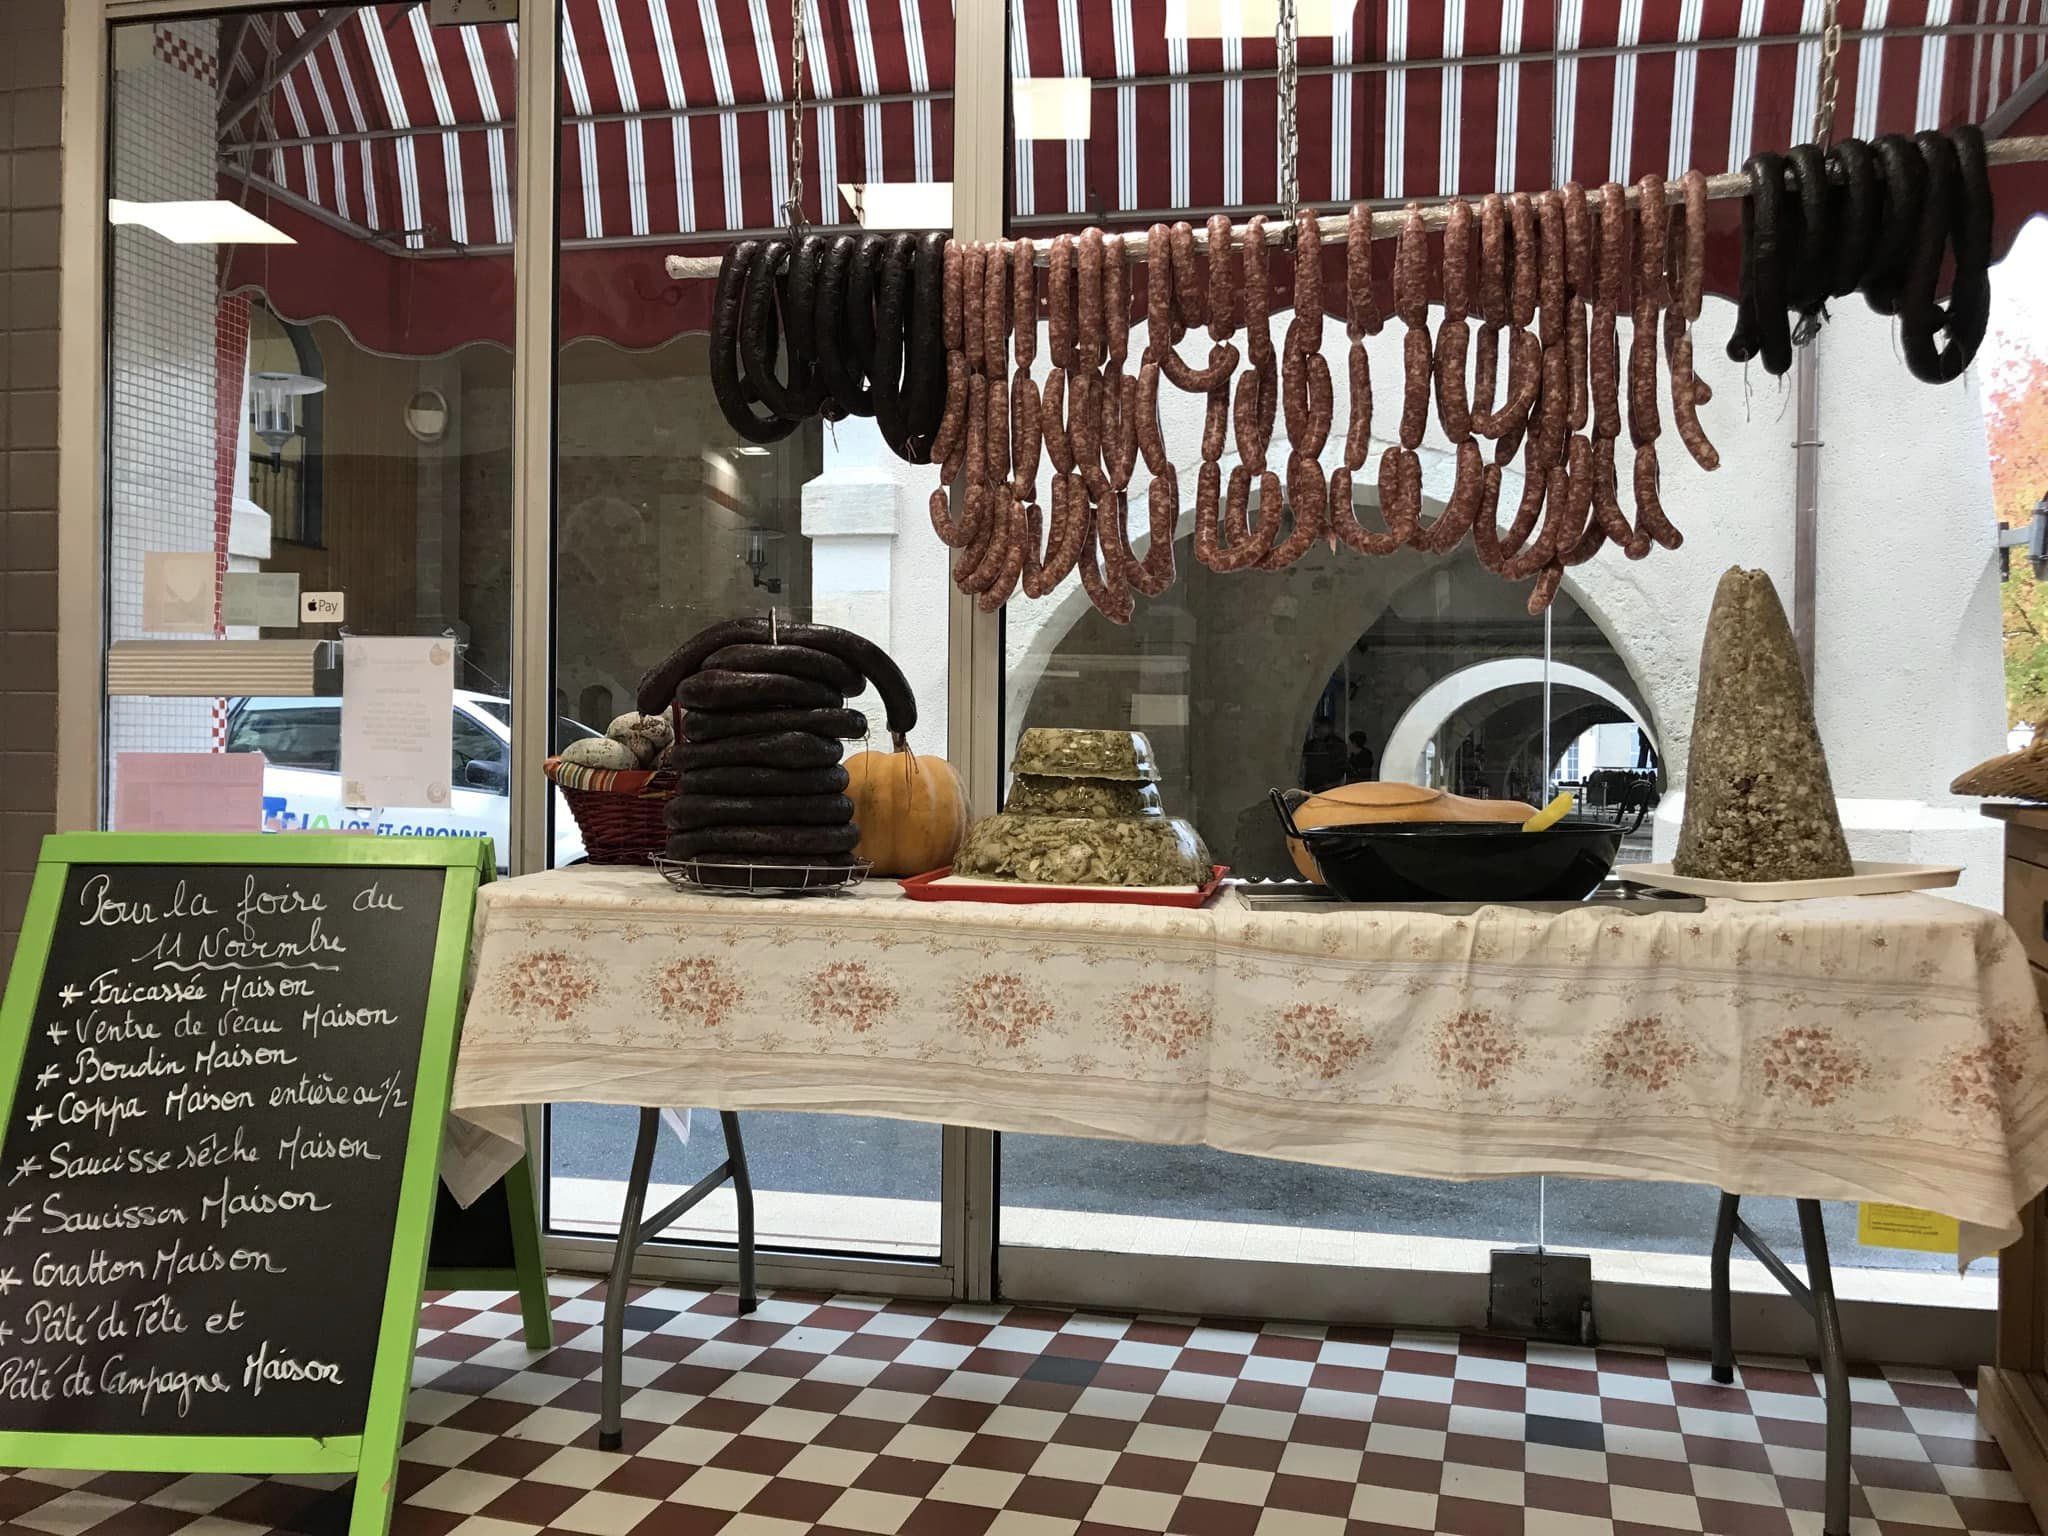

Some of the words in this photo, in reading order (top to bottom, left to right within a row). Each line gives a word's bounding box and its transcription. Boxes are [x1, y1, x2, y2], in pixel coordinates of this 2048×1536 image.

[319, 599, 338, 615] Pay
[80, 873, 157, 926] Pour
[164, 879, 218, 918] la
[236, 873, 327, 941] foire
[352, 881, 403, 912] du
[132, 932, 181, 963] 11
[198, 916, 346, 961] Novembre
[88, 969, 208, 1005] Fricassée
[220, 974, 315, 1006] Maison
[75, 1010, 161, 1044] Ventre
[174, 1009, 206, 1037] de
[217, 1008, 282, 1036] Veau
[302, 1003, 398, 1038] Maison
[68, 1047, 185, 1086] Boudin
[194, 1041, 297, 1075] Maison
[58, 1092, 147, 1136] Coppa
[165, 1083, 254, 1121] Maison
[269, 1075, 348, 1106] entière
[48, 1141, 172, 1180] Saucisse
[278, 1126, 381, 1170] Maison
[42, 1192, 189, 1234] Saucisson
[201, 1176, 332, 1229] Maison
[32, 1250, 145, 1287] Gratton
[152, 1238, 287, 1284] Maison
[21, 1300, 100, 1345] Pâté
[97, 1300, 128, 1341] de
[133, 1294, 188, 1338] Tête
[205, 1300, 245, 1334] et
[0, 1354, 72, 1401] Pâté
[62, 1354, 94, 1398] de
[100, 1354, 231, 1417] Campagne
[243, 1340, 344, 1397] Maison
